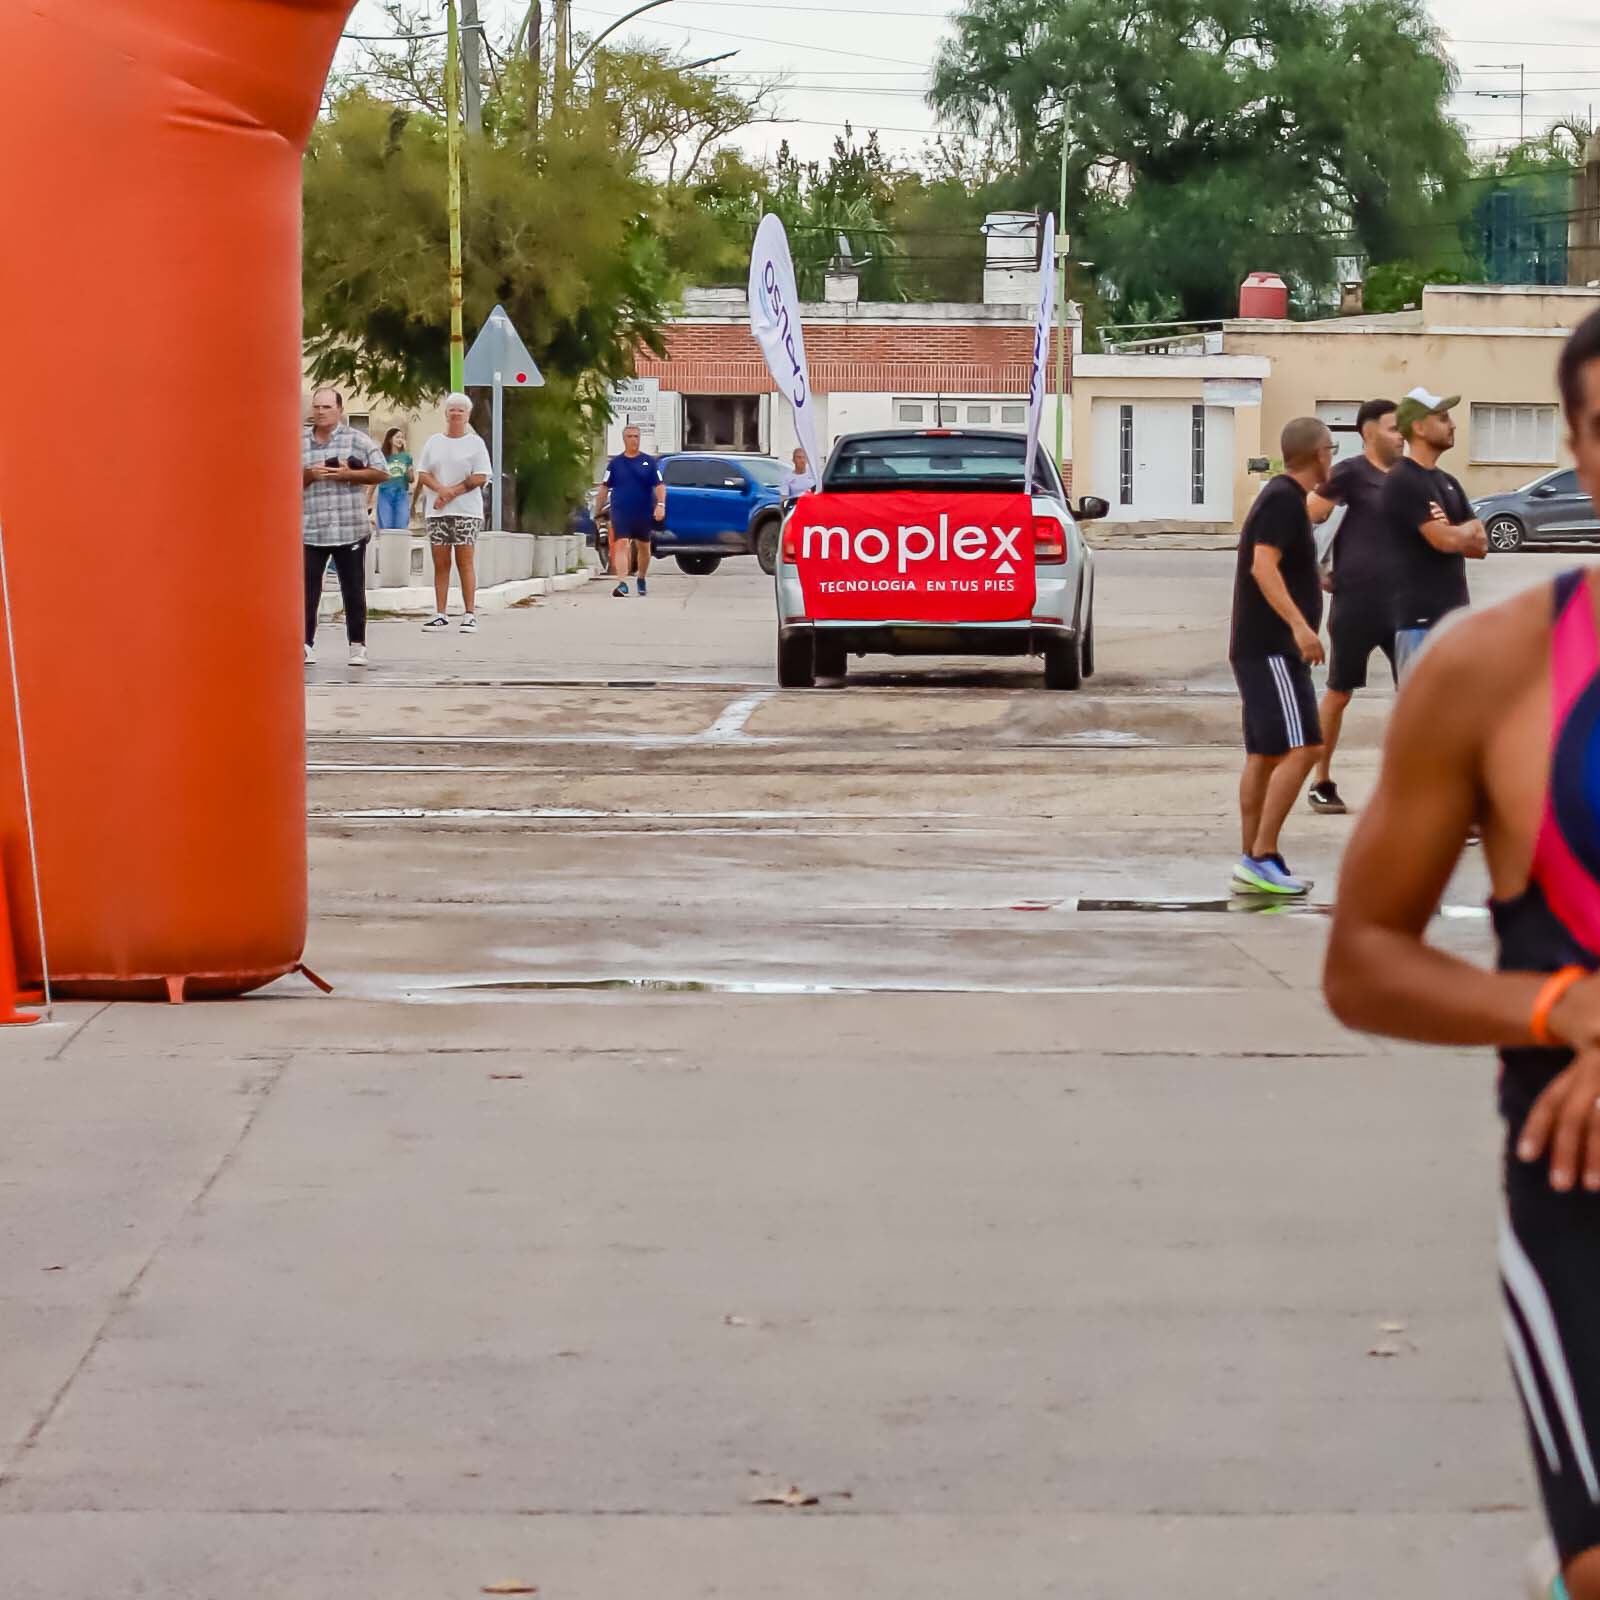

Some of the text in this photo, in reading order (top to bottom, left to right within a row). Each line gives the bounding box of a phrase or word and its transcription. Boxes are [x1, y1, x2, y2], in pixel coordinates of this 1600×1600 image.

[802, 513, 1022, 574] moplex
[820, 580, 1015, 593] TECNOLOGIA EN TUS PIES
